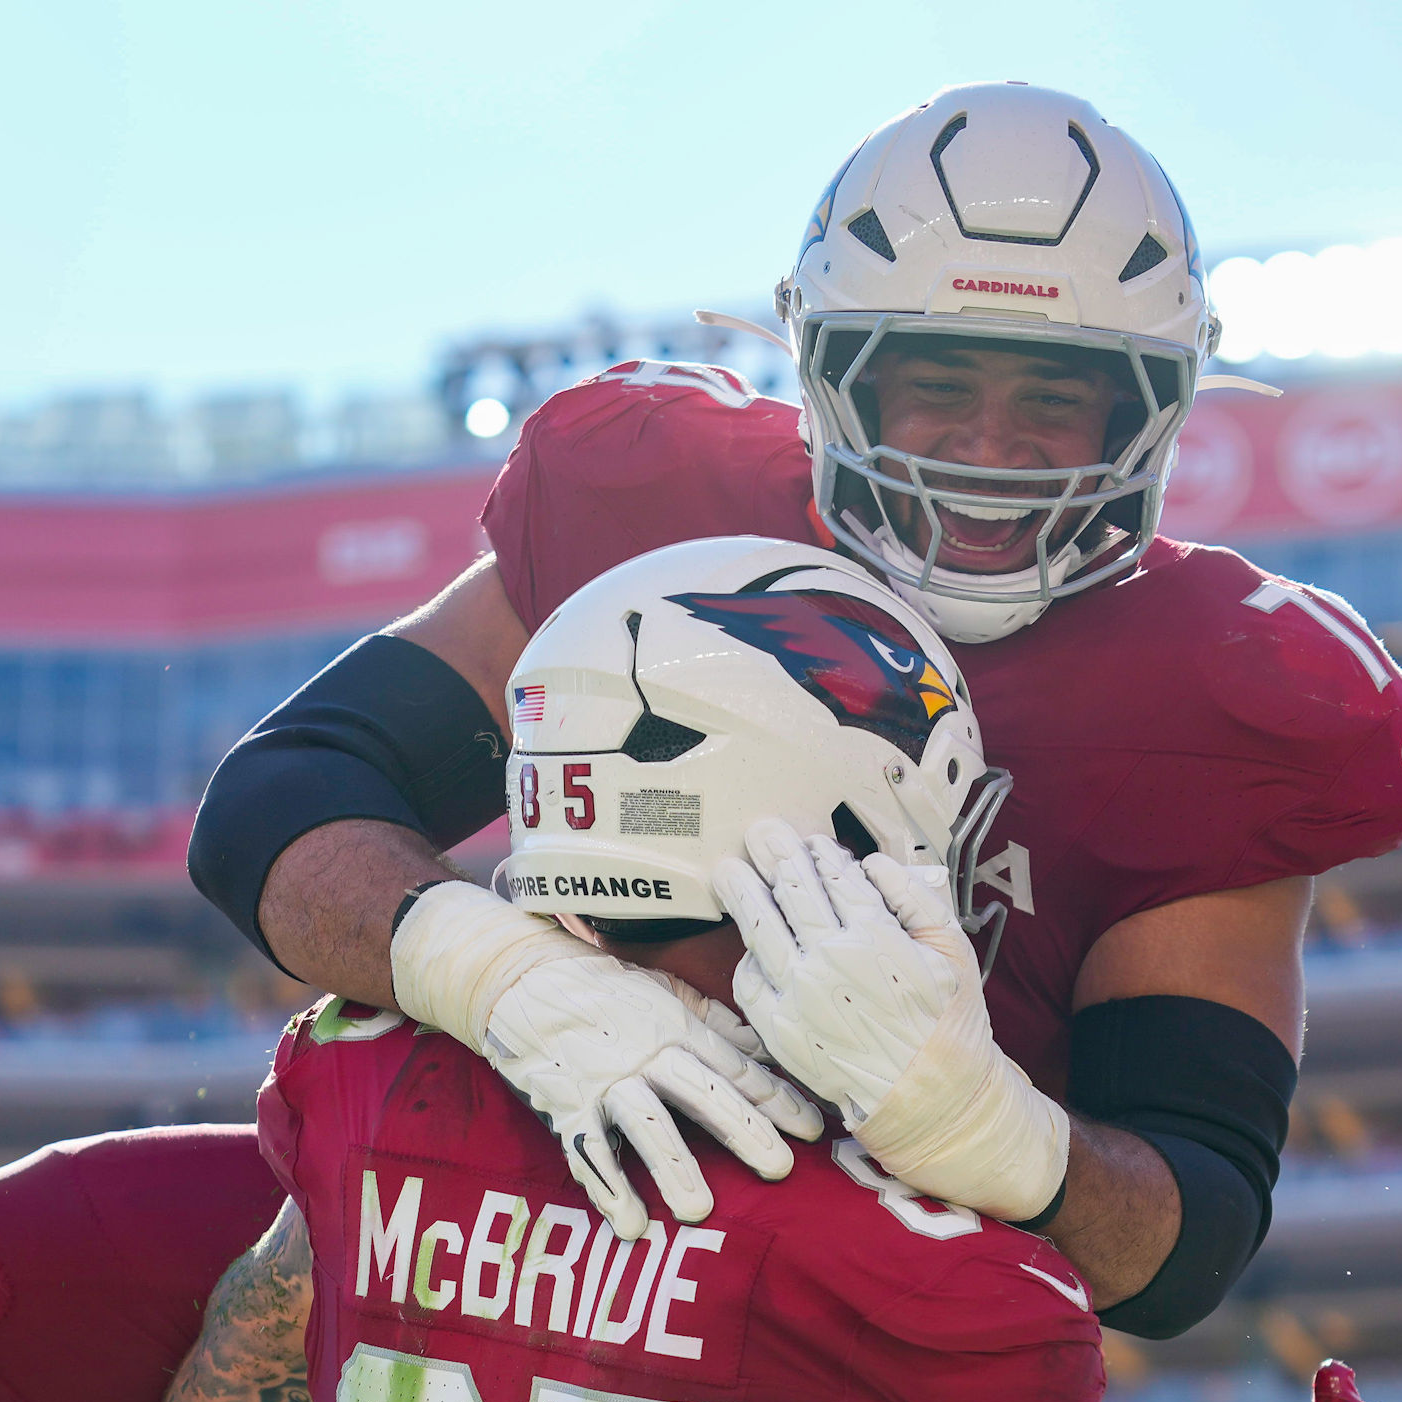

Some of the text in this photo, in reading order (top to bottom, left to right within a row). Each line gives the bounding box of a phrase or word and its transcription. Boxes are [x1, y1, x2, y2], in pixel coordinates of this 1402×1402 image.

[952, 278, 1060, 298] CARDINALS
[554, 875, 673, 900] CHANGE
[355, 1169, 727, 1360] McBRIDE
